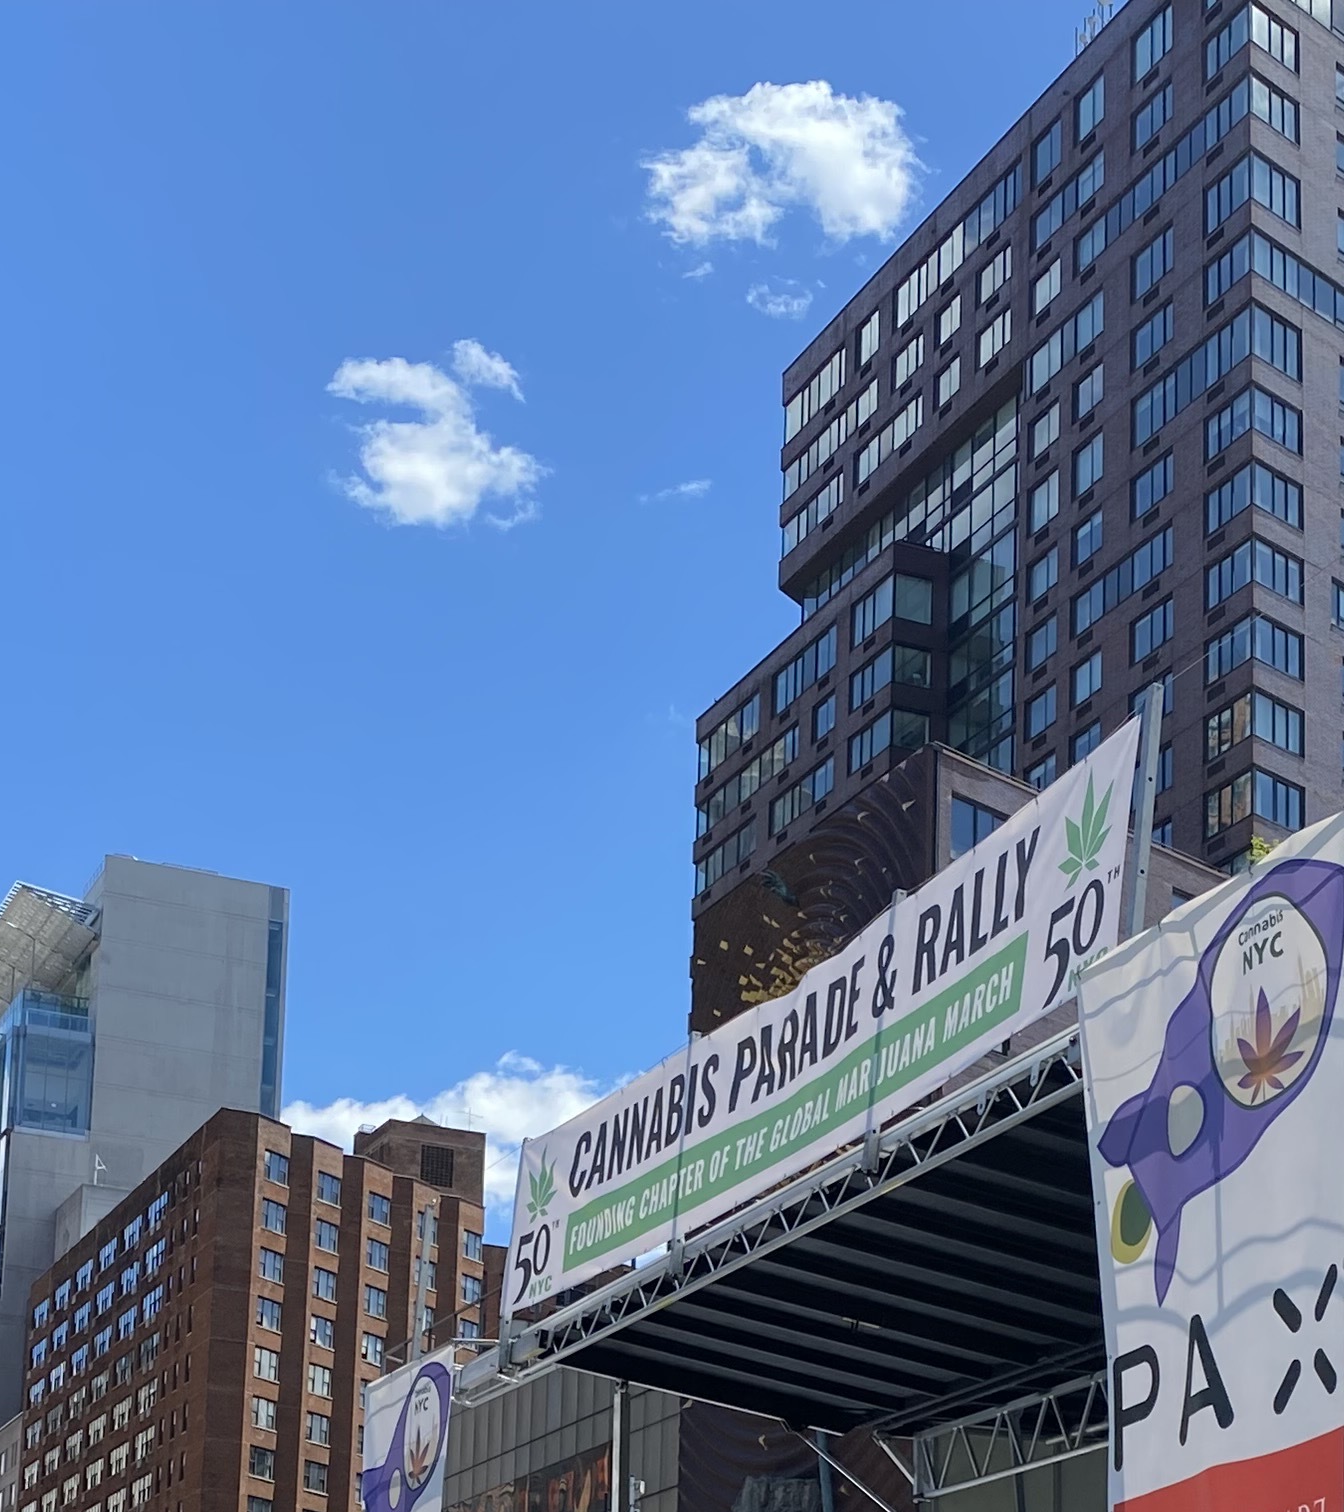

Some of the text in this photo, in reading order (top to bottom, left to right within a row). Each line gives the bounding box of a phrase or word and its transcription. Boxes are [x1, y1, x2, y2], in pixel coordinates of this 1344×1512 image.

[1238, 910, 1284, 947] Cannabis
[1242, 931, 1285, 976] NYC
[568, 825, 1042, 1199] CANNABIS PARADE & RALLY
[569, 1205, 634, 1256] FOUNDING
[640, 1164, 704, 1223] CHAPTER
[710, 1152, 731, 1183] OF
[735, 1124, 766, 1169] THE
[769, 1088, 830, 1150] GLOBAL
[836, 1016, 936, 1113] MARIJUANA
[942, 962, 1015, 1044] MARCH
[529, 1275, 553, 1299] NYC
